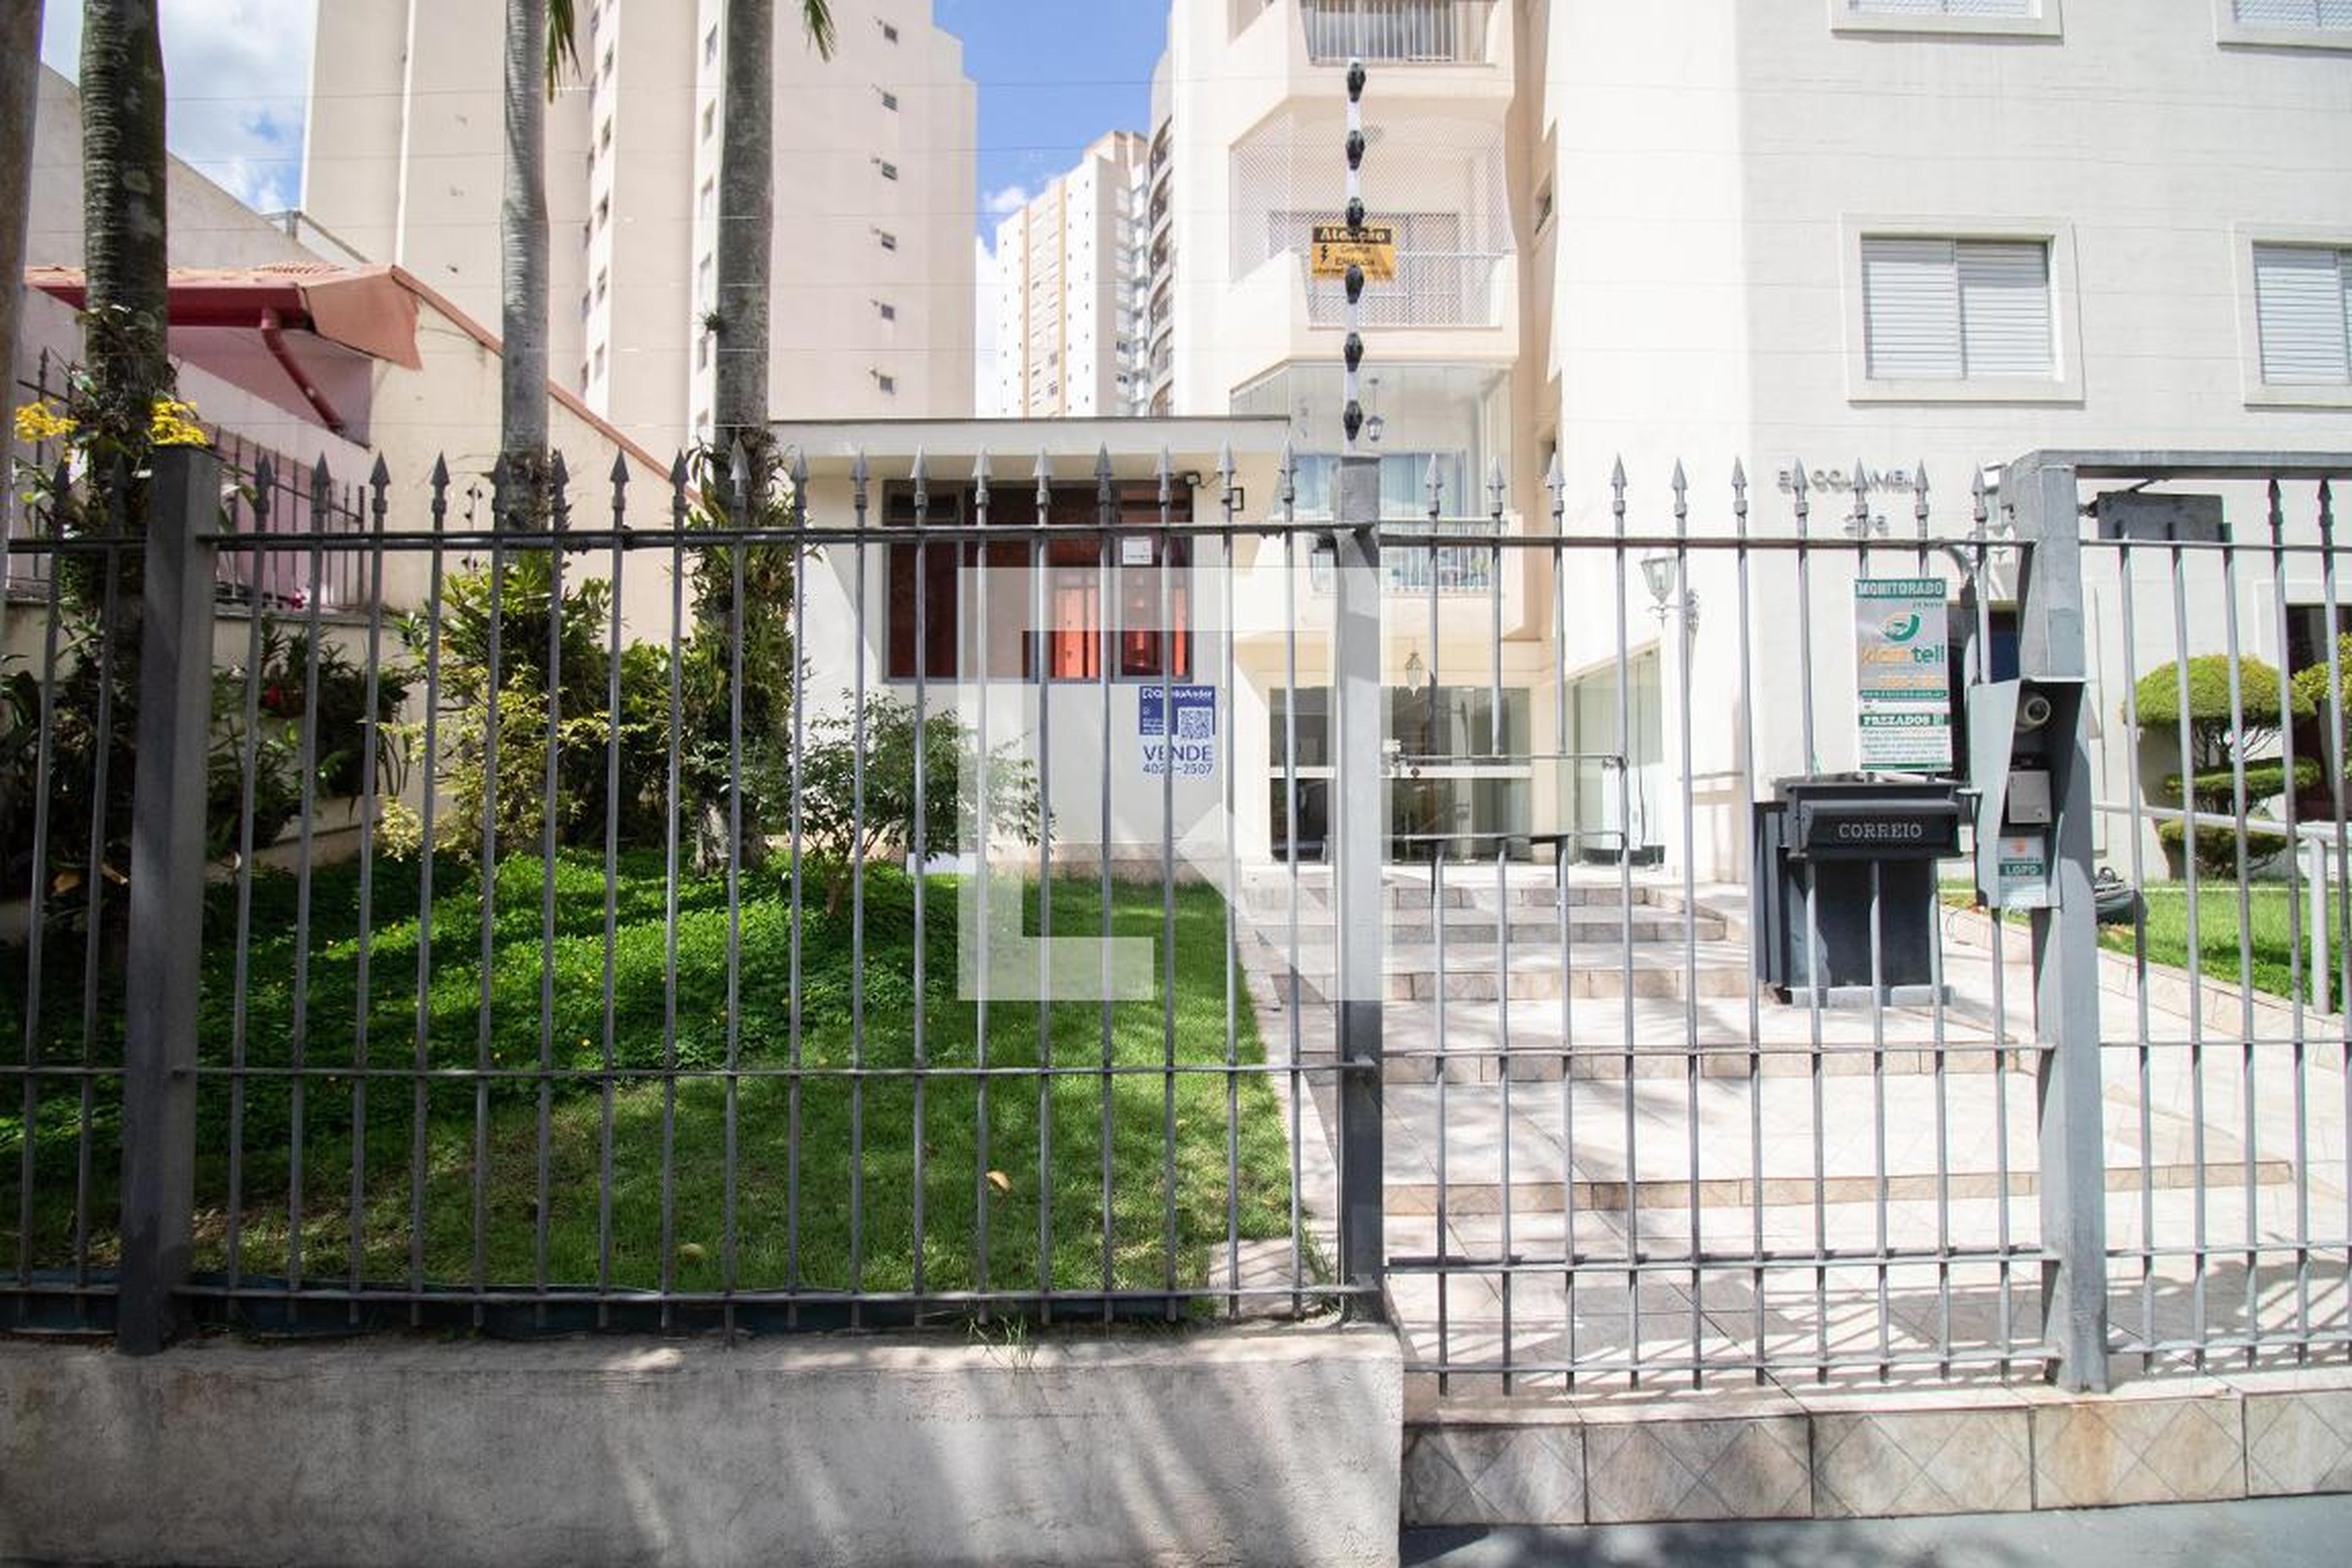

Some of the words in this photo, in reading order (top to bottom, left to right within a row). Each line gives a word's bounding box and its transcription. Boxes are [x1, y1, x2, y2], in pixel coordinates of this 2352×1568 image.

[1857, 581, 1943, 595] MONITORADO
[1142, 744, 1213, 761] VENDE
[1142, 763, 1213, 775] 402-2507
[1838, 823, 1923, 839] CORREIO
